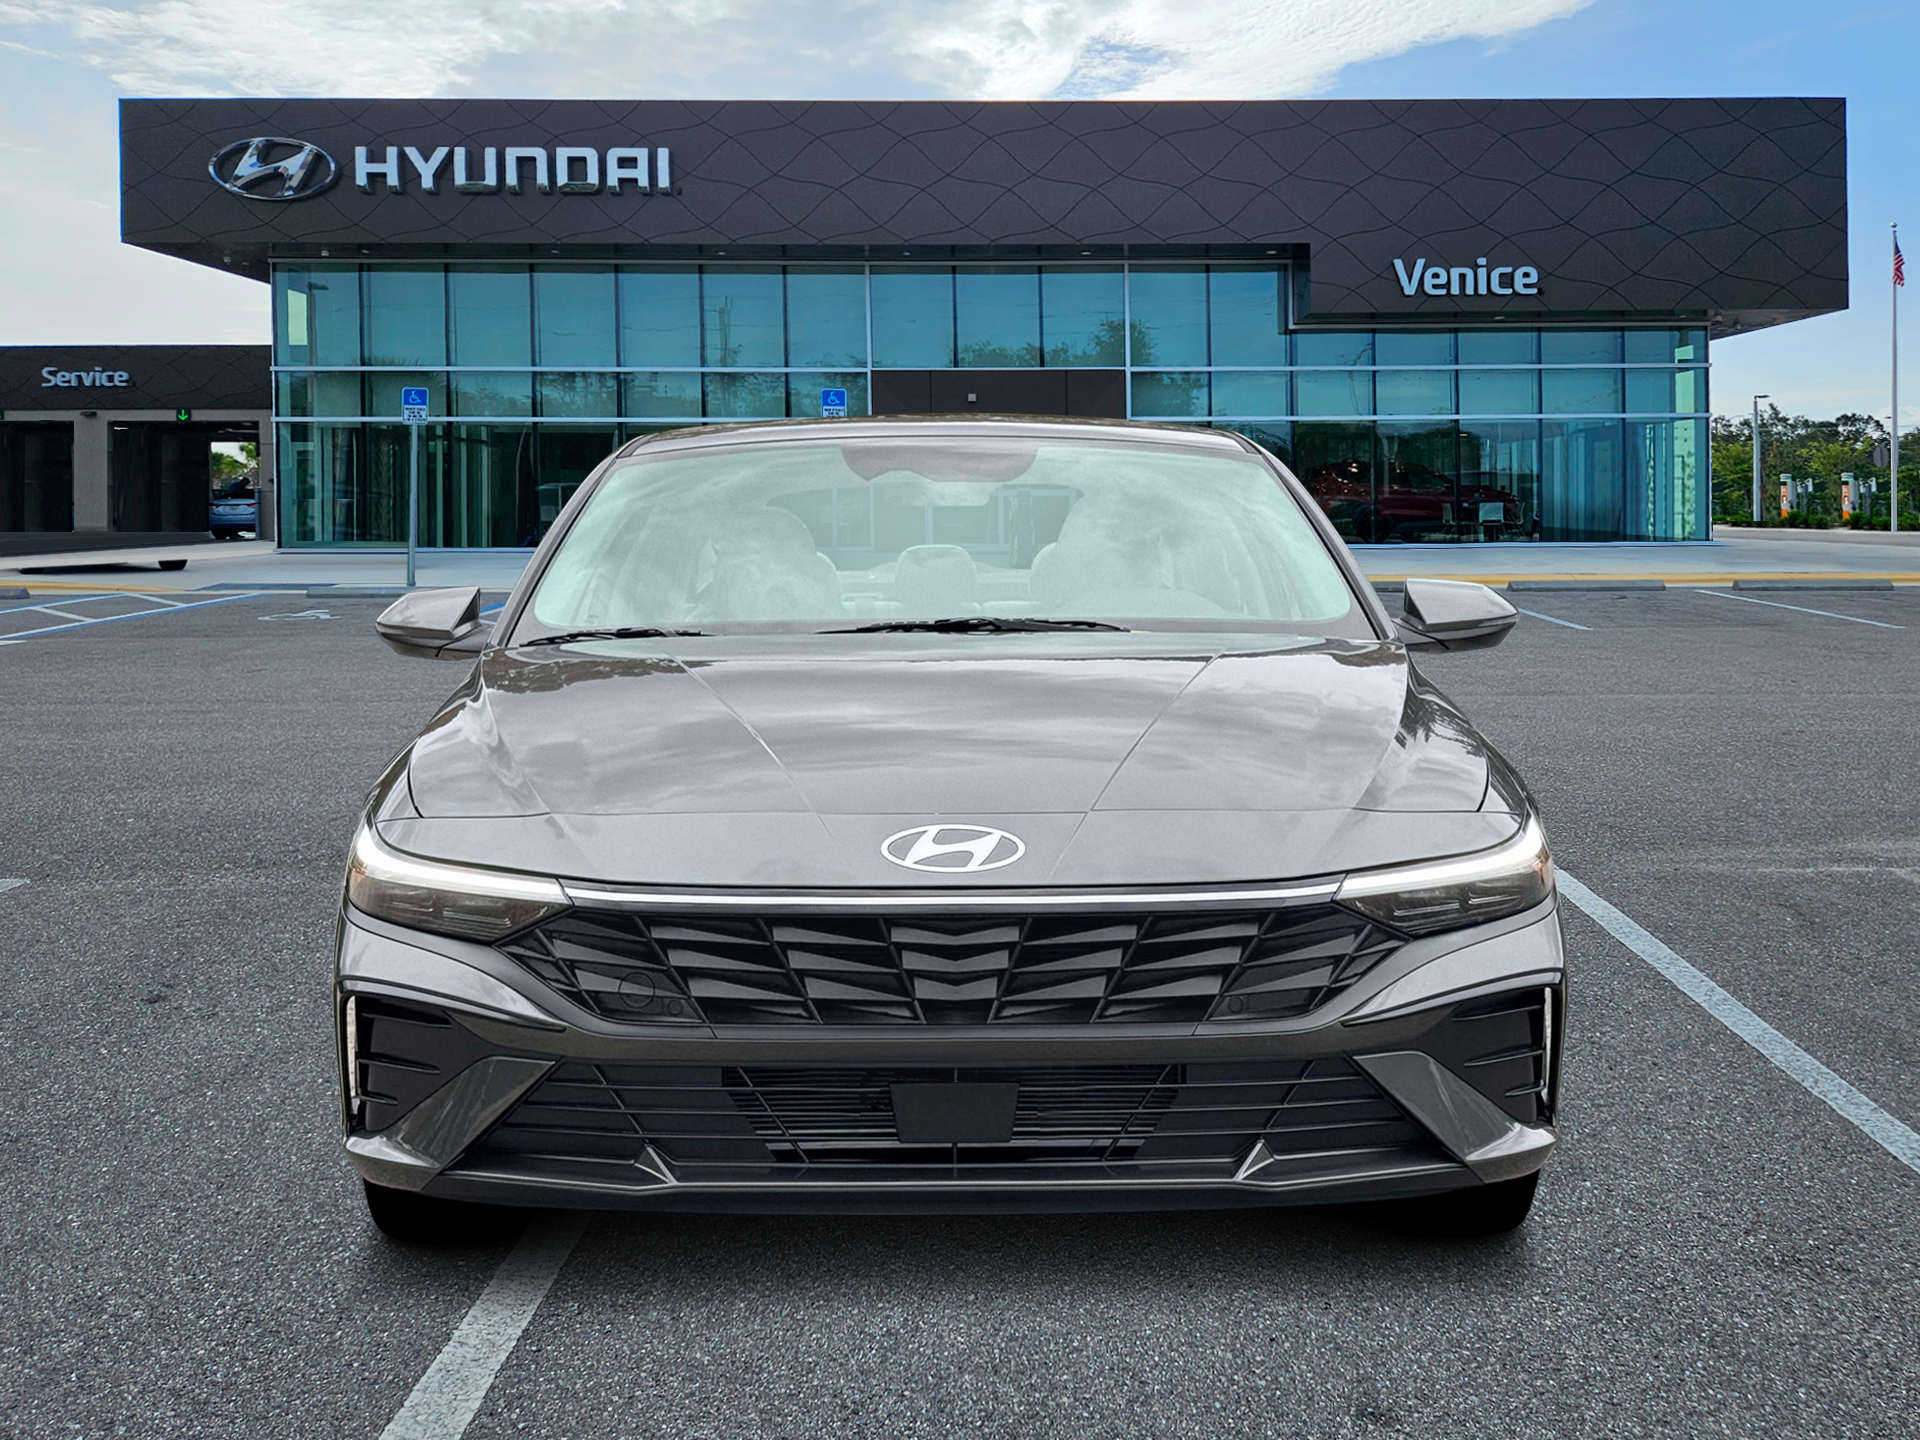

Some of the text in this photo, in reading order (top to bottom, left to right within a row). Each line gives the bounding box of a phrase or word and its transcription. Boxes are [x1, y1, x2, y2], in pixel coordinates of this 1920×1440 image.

[354, 145, 673, 194] HYUNDAI
[1392, 256, 1539, 296] Venice
[41, 366, 130, 387] Service
